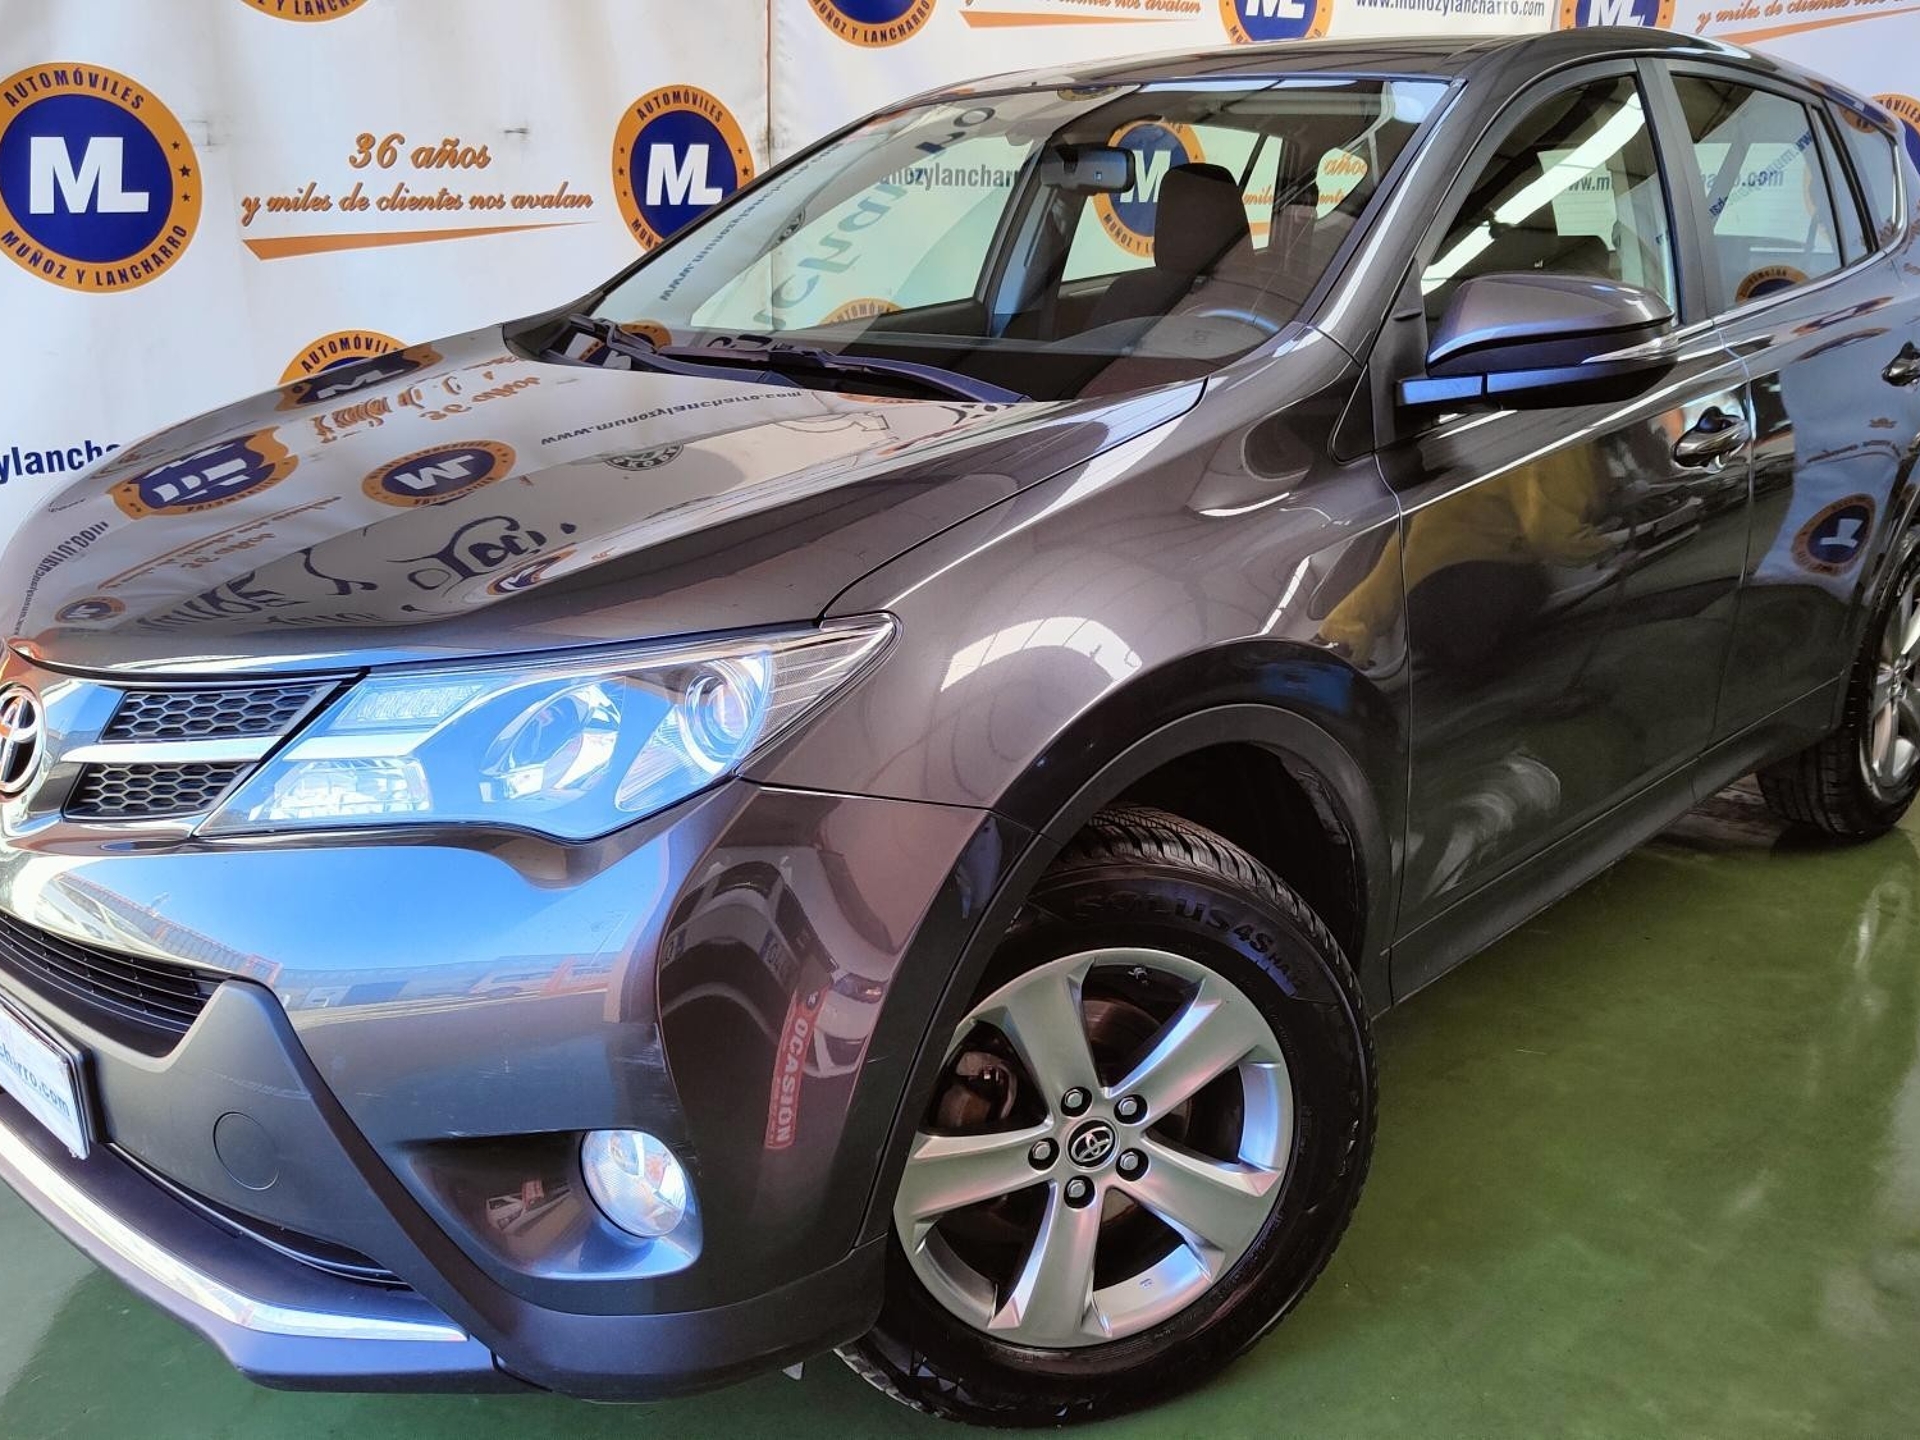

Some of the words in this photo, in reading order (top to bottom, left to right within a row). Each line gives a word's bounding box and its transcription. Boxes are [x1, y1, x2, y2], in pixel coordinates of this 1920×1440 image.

[863, 1, 930, 42] LANCHARRO
[1696, 12, 1712, 34] y
[1716, 1, 1761, 22] miles
[1764, 0, 1784, 16] de
[4, 68, 144, 110] AUTOMÓVILES
[636, 90, 724, 124] AUTOMÓVILES
[349, 132, 405, 169] 36
[410, 137, 492, 169] años
[29, 136, 150, 214] ML
[646, 143, 723, 206] ML
[241, 197, 260, 227] y
[267, 182, 333, 212] miles
[339, 182, 370, 212] de
[376, 182, 463, 212] clientes
[469, 193, 507, 211] nos
[511, 181, 594, 210] avalan
[1, 229, 68, 280] MUÑOZ
[76, 269, 86, 284] Y
[95, 225, 188, 287] LANCHARRO
